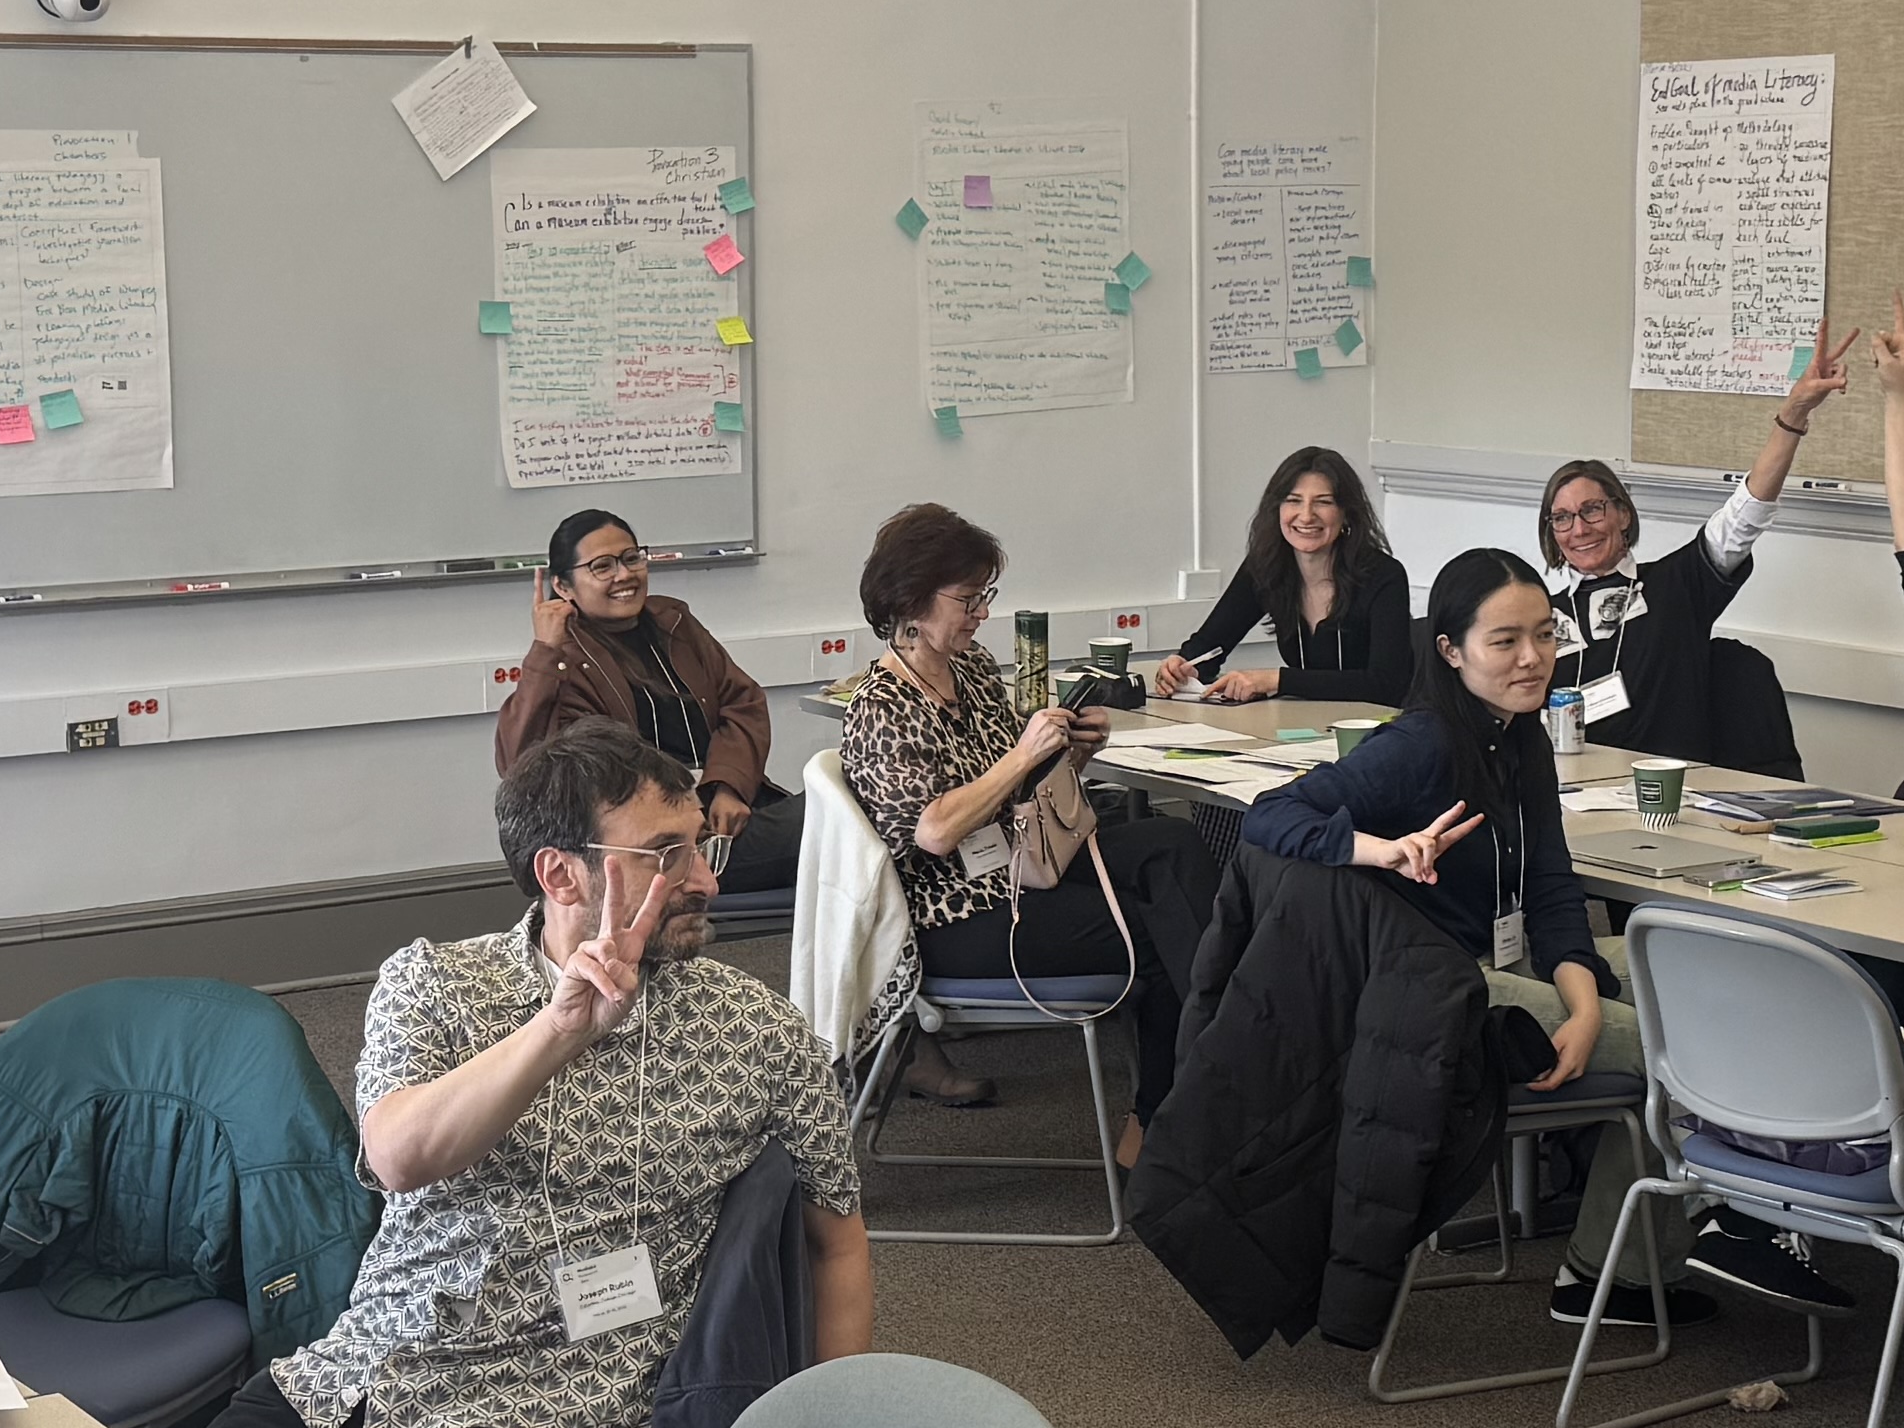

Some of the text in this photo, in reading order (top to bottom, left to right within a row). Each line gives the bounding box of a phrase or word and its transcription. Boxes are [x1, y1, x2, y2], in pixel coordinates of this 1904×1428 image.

[705, 147, 719, 164] 3
[1241, 145, 1267, 155] media
[666, 168, 725, 185] Christian
[609, 1280, 633, 1291] Rubin
